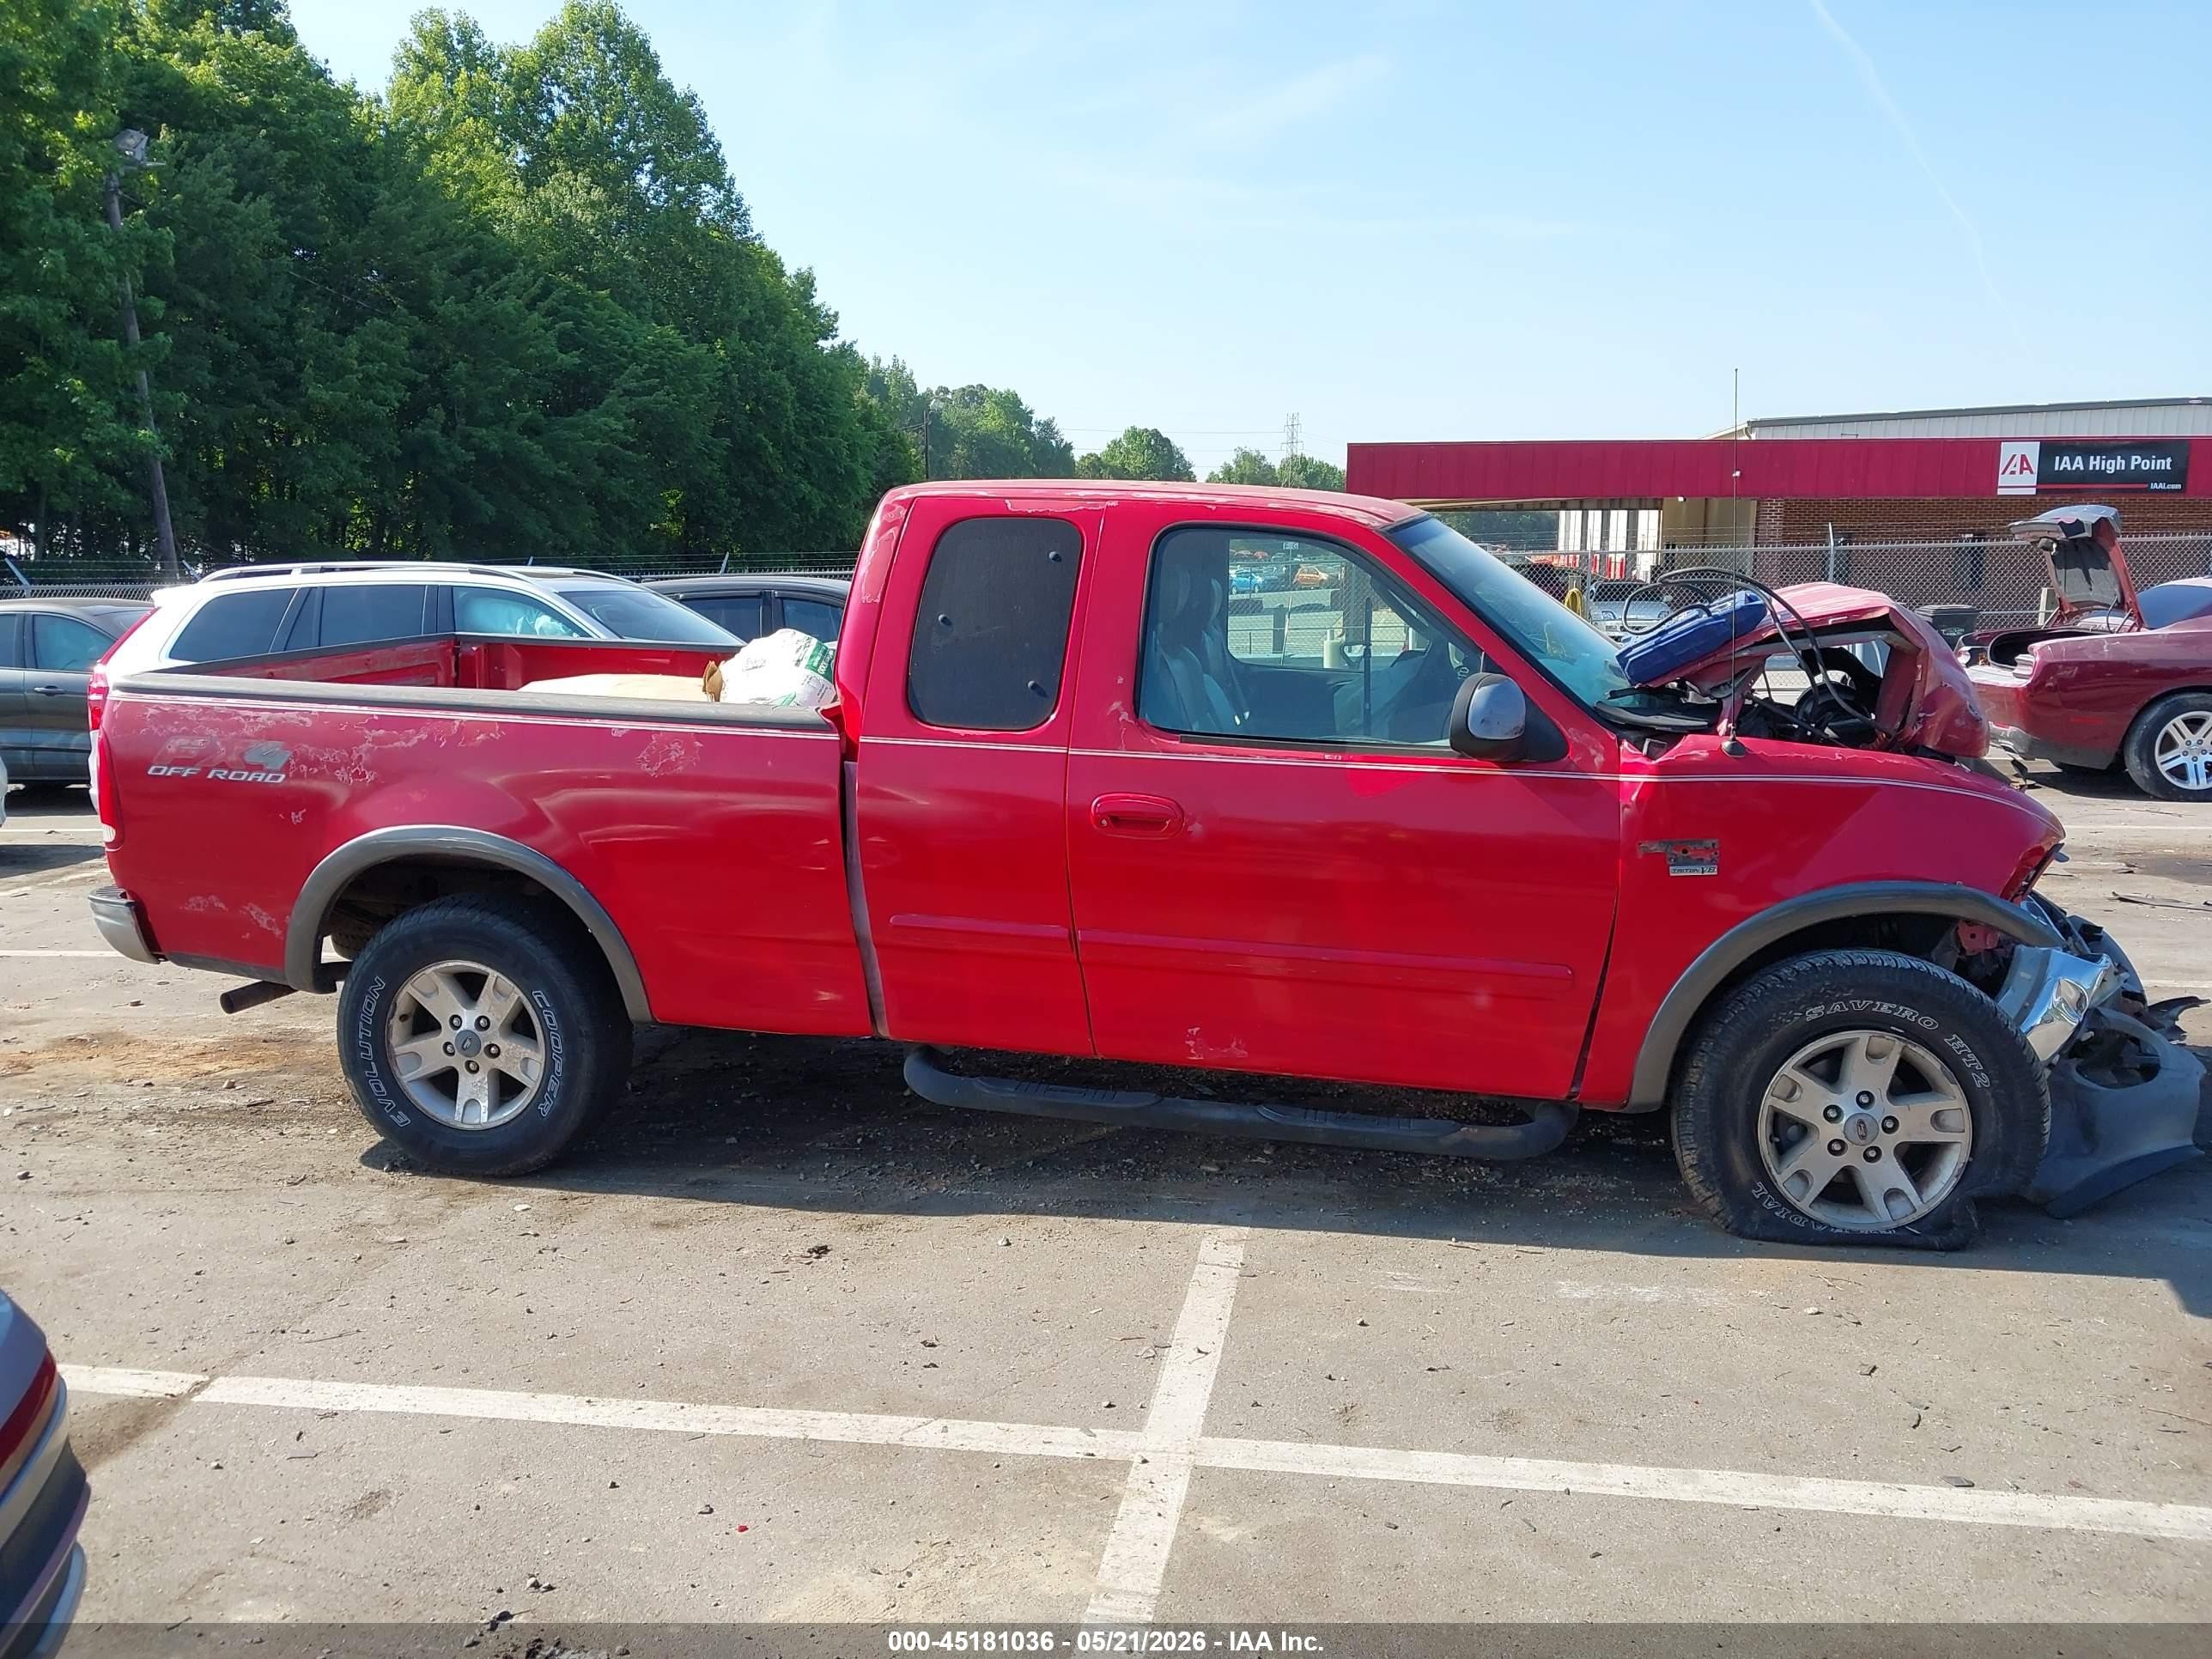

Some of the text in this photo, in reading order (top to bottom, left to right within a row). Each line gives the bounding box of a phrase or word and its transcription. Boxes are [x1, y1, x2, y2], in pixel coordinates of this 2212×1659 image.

[2055, 456, 2172, 473] IAA High Point
[148, 766, 286, 783] OFF ROAD
[1701, 866, 1717, 874] V8
[358, 976, 410, 1127] EVOLUTION
[532, 990, 563, 1117] COOPER
[1805, 1000, 1991, 1088] SAVERO HT2
